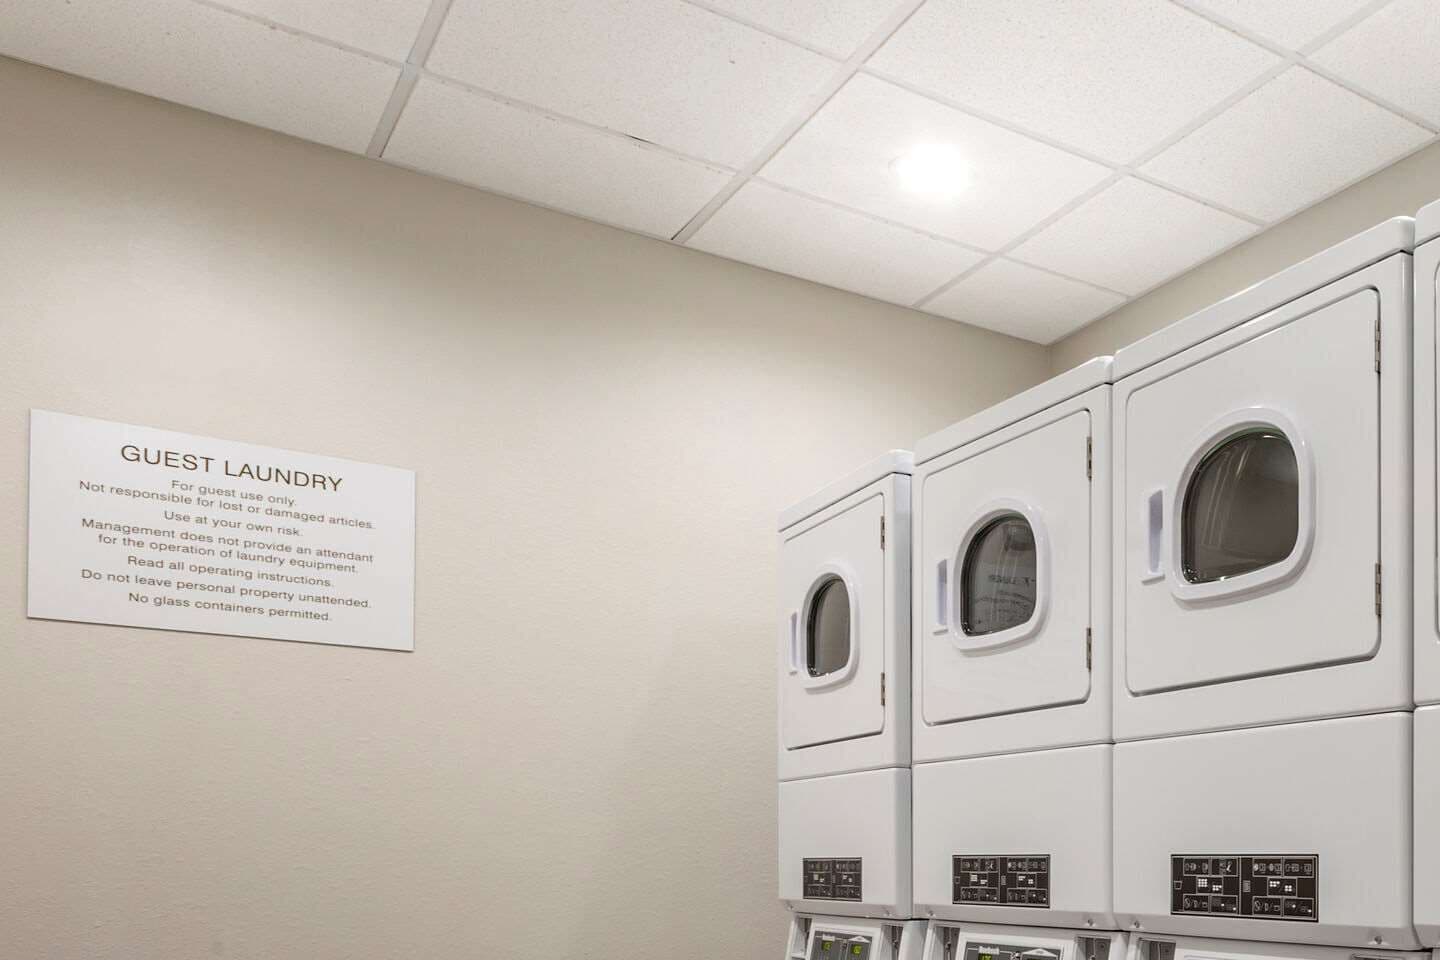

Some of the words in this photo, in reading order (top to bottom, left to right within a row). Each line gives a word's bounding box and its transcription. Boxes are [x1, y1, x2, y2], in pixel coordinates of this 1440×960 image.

[121, 445, 215, 472] GUEST
[224, 460, 342, 491] LAUNDRY
[80, 480, 104, 493] Not
[110, 486, 192, 505] responsible
[197, 497, 214, 507] for
[220, 500, 242, 511] lost
[247, 505, 261, 513] or
[265, 507, 324, 523] damaged
[329, 515, 376, 529] articles.
[171, 480, 194, 492] For
[198, 486, 236, 498] guest
[240, 491, 263, 501] use
[268, 495, 297, 507] only.
[82, 518, 175, 538] Management
[180, 531, 214, 543] does
[218, 536, 239, 546] not
[244, 540, 292, 553] provide
[296, 546, 311, 555] an
[316, 549, 373, 562] attendant
[164, 510, 190, 522] Use
[195, 515, 207, 525] at
[212, 519, 241, 529] your
[246, 523, 273, 533] own
[278, 526, 303, 536] risk.
[98, 534, 117, 544] for
[122, 537, 145, 548] the
[149, 542, 215, 556] operation
[220, 549, 233, 558] of
[237, 551, 285, 566] laundry
[289, 558, 359, 573] equipment.
[127, 555, 164, 569] Read
[169, 561, 184, 570] all
[189, 564, 253, 580] operating
[257, 571, 334, 587] instructions.
[81, 569, 101, 580] Do
[107, 573, 130, 583] not
[135, 576, 172, 587] leave
[176, 581, 235, 594] personal
[240, 586, 294, 602] property
[299, 593, 372, 608] unattended.
[129, 592, 149, 603] No
[153, 596, 191, 607] glass
[195, 600, 265, 615] containers
[269, 606, 333, 621] permitted.
